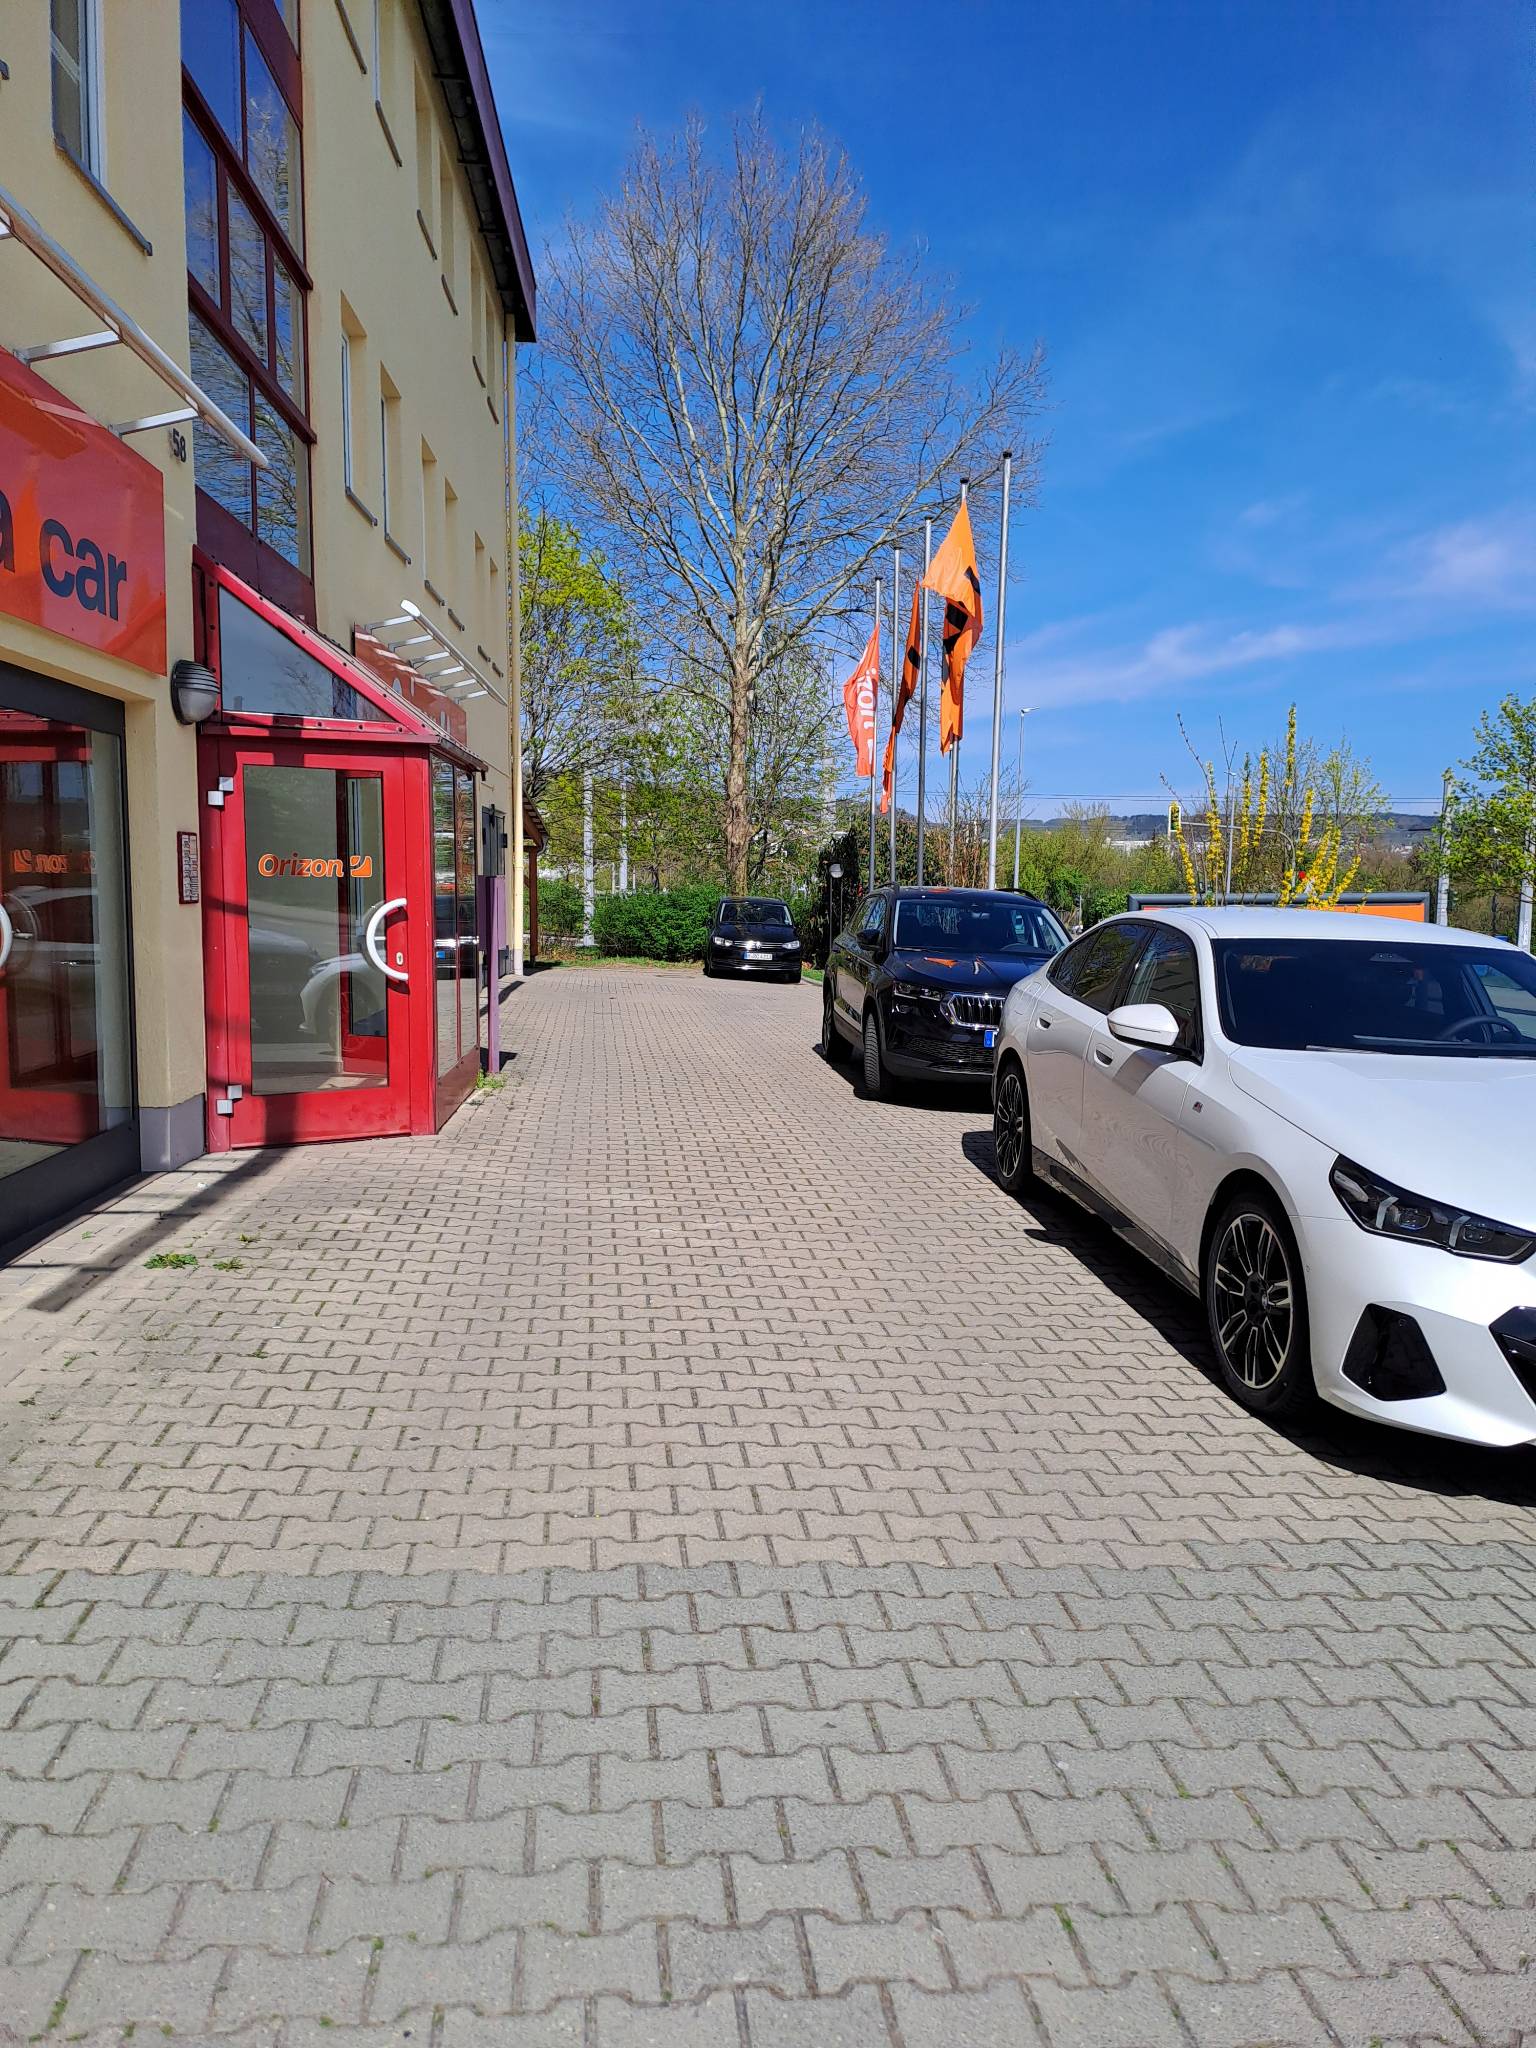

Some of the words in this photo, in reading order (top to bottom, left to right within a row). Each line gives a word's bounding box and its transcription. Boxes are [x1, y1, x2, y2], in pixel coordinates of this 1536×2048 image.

[172, 427, 186, 463] 58
[39, 518, 127, 621] car
[258, 852, 344, 877] Orizon
